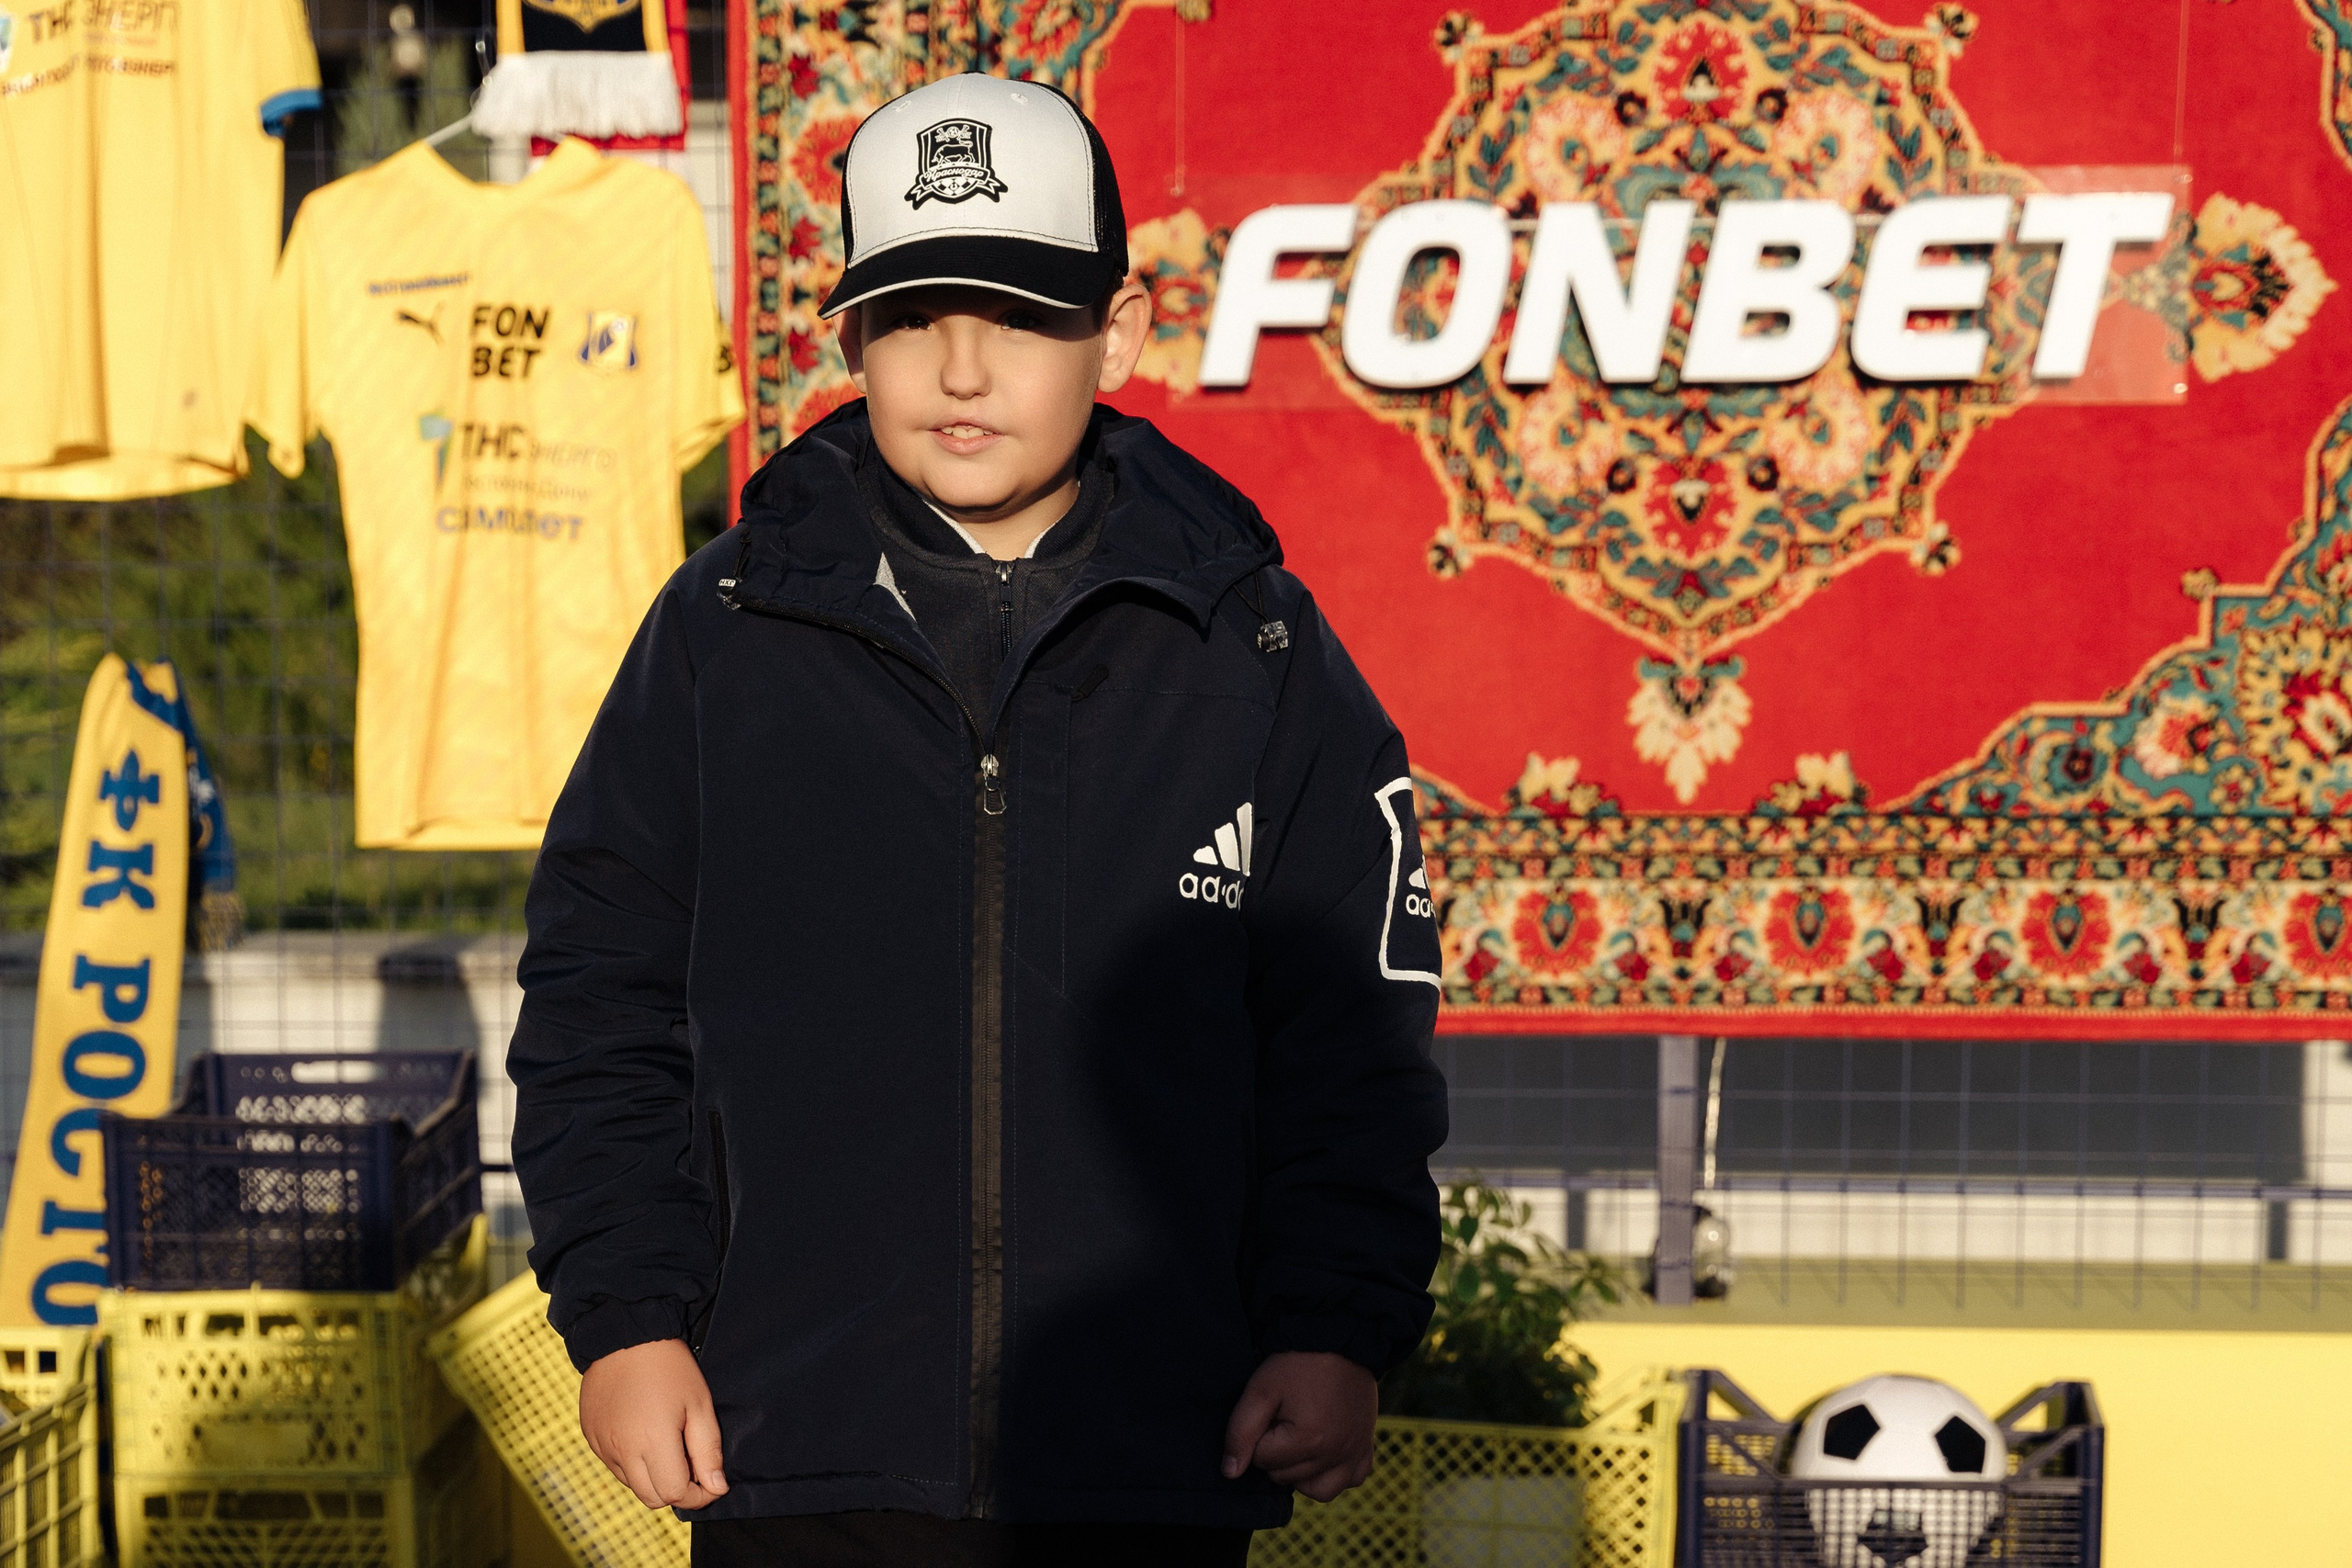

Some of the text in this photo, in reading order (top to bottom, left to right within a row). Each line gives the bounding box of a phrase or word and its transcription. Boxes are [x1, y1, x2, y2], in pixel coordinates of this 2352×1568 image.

[472, 305, 549, 339] FON
[1198, 192, 2176, 389] FONBET
[472, 346, 541, 378] BET
[83, 750, 159, 908] ФК
